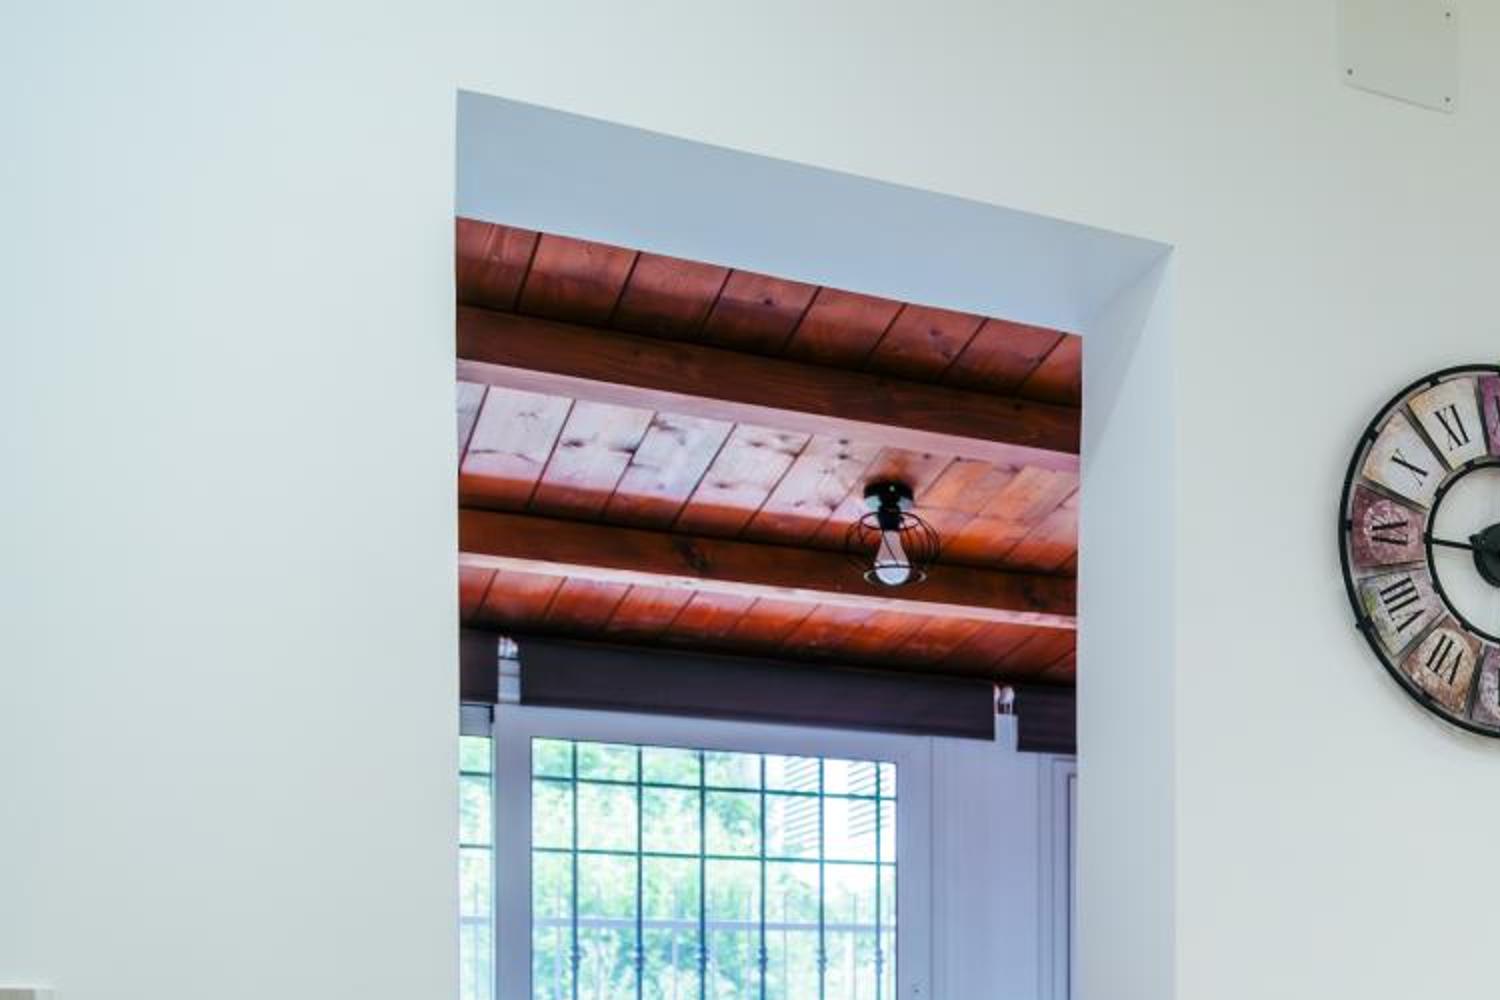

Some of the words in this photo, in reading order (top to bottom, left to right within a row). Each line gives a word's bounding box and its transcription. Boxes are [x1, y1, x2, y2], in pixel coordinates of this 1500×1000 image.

[1434, 404, 1470, 451] XI
[1390, 449, 1428, 486] X
[1370, 512, 1409, 546] IX
[1379, 576, 1425, 633] VIII
[1424, 634, 1465, 686] VII
